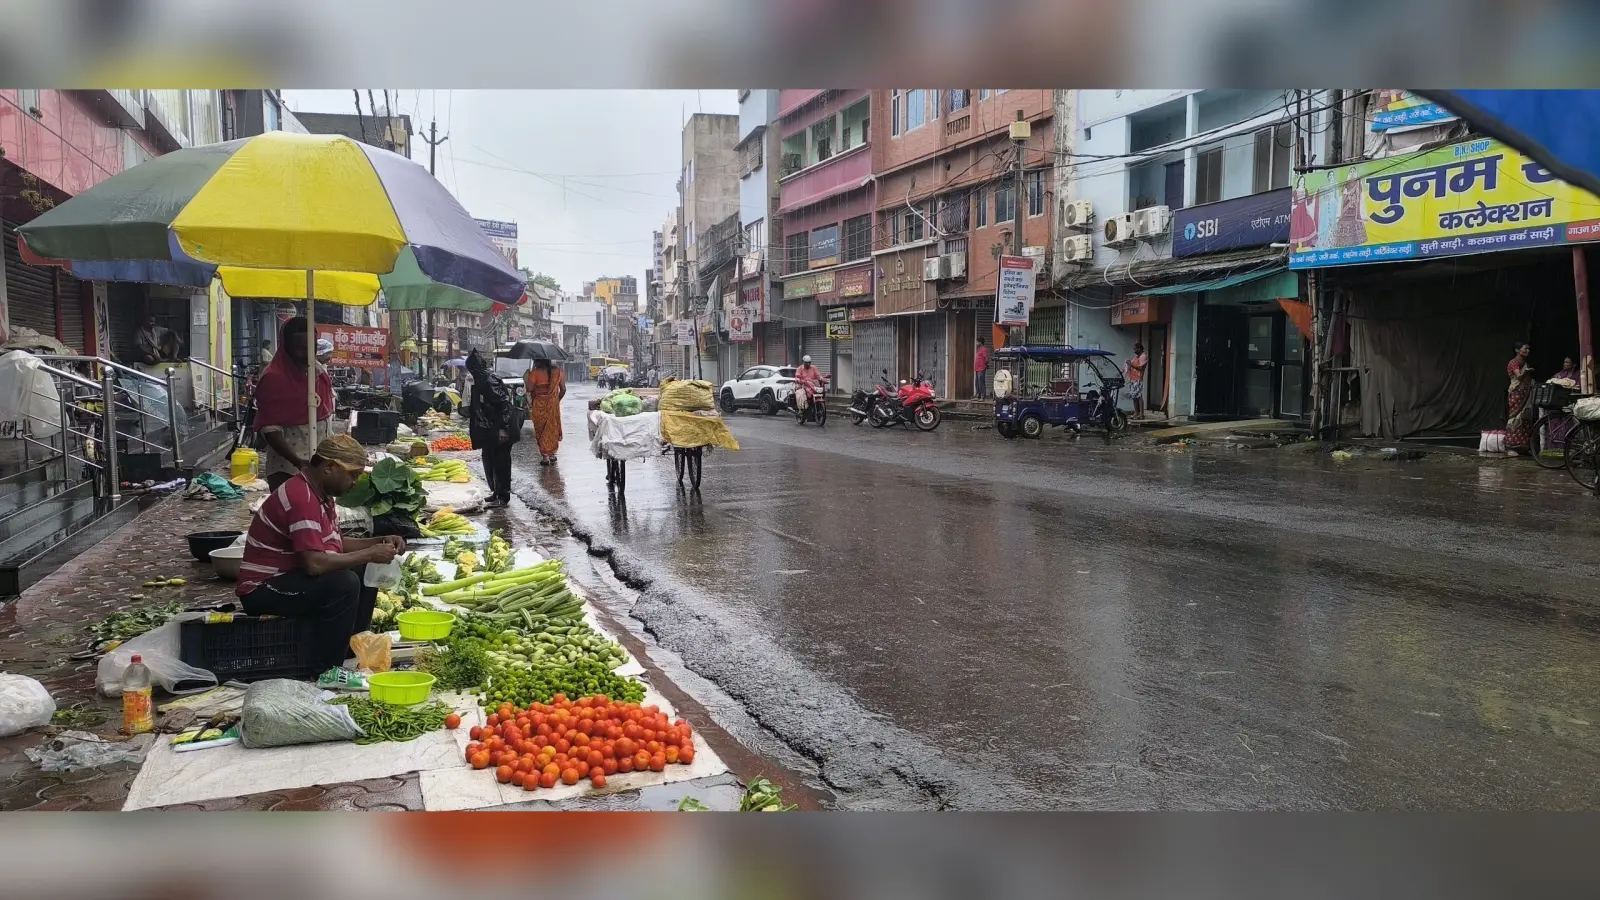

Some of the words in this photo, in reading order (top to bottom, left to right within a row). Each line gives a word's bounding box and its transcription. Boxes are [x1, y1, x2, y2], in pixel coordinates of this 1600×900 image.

[1470, 140, 1491, 154] SHOP
[1366, 152, 1504, 225] पुनम
[1250, 217, 1271, 230] एटीएम
[1274, 213, 1291, 226] ATM
[1438, 197, 1555, 230] कलेक्शन
[1197, 217, 1219, 238] SBI
[1567, 225, 1590, 236] गाउन
[1420, 238, 1438, 254] सुती
[1467, 232, 1507, 247] कलकत्ता
[1509, 230, 1528, 242] वर्क
[1529, 226, 1555, 241] साड़ी
[975, 297, 995, 309] JEWE
[334, 328, 349, 343] बैंक
